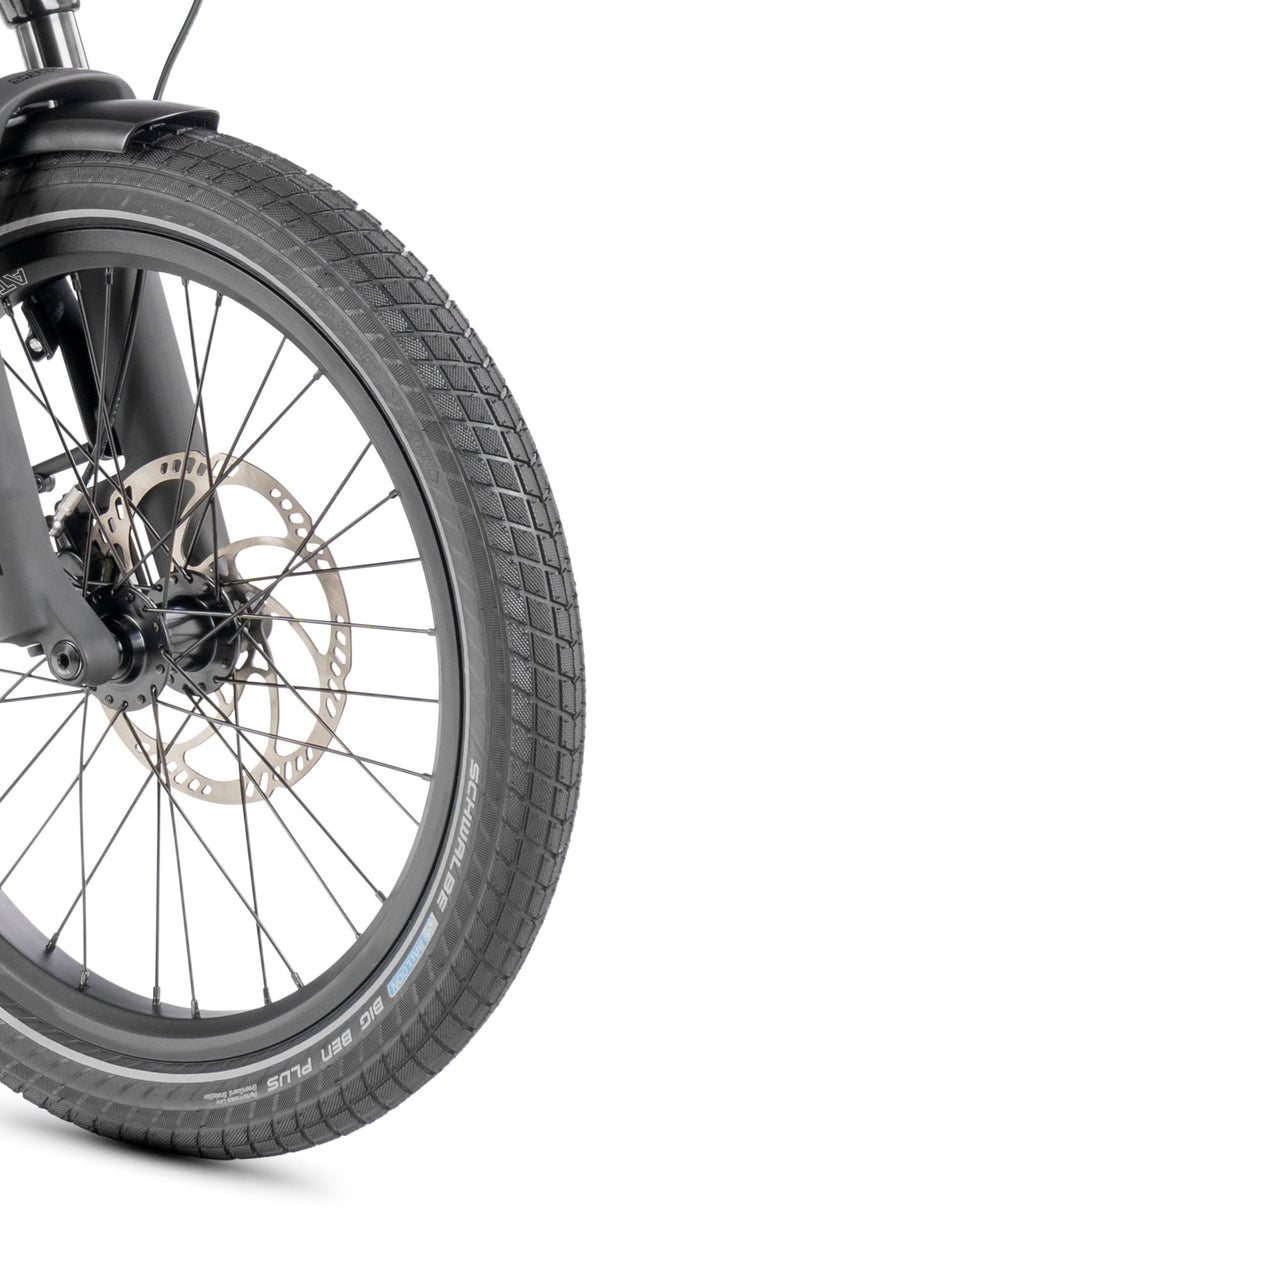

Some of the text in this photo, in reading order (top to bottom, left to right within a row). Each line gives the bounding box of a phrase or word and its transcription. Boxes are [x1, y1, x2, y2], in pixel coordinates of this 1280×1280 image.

[436, 758, 480, 912] SCHWALBE
[359, 995, 384, 1031] BIG
[266, 1057, 313, 1093] PLUS
